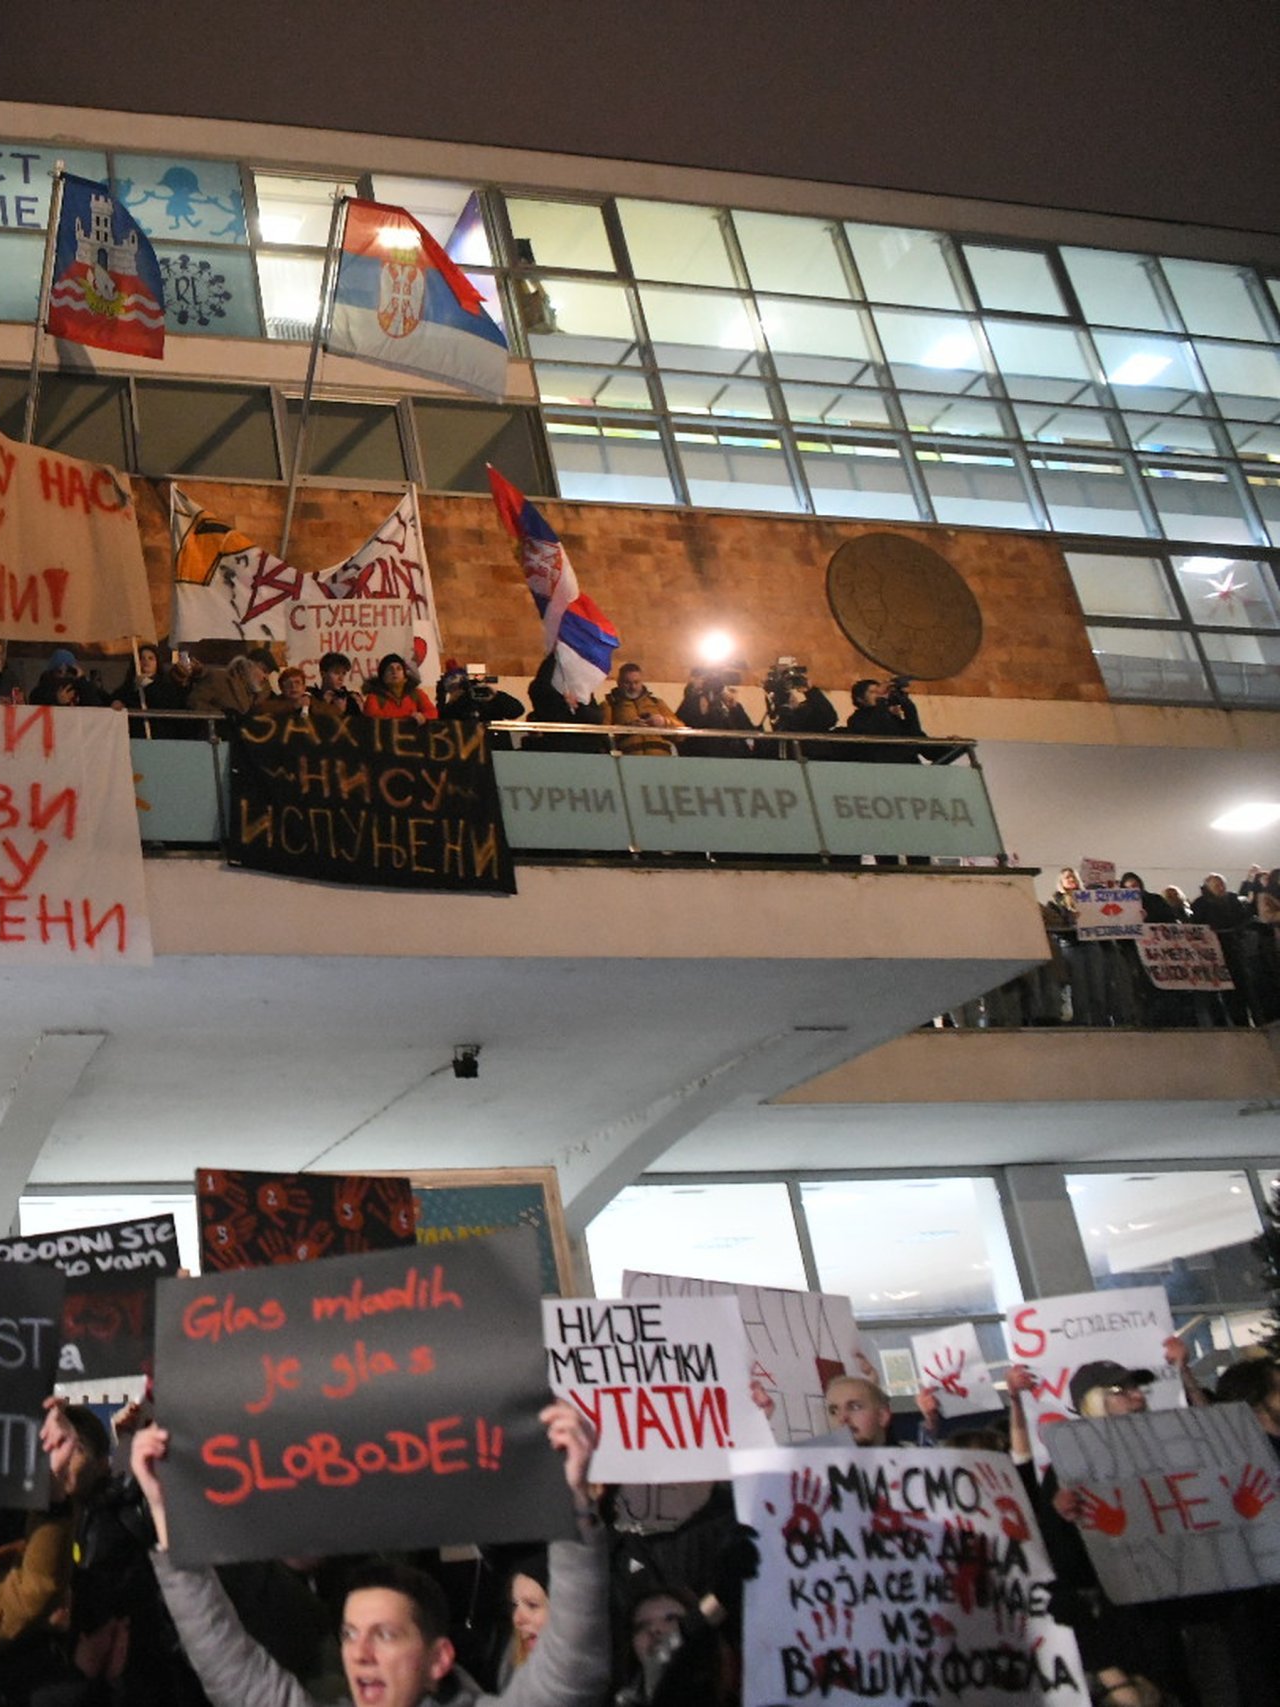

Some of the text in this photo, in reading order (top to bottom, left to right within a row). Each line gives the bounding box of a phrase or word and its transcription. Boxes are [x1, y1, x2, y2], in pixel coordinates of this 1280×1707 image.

[289, 603, 413, 631] СТУДЕНТИ
[320, 630, 379, 653] НИСУ
[298, 755, 449, 812] НИСУ
[640, 785, 799, 824] ЦЕНТАР
[833, 794, 976, 827] БЕОГРАД
[239, 798, 499, 881] ИСПУЊЕНИ
[182, 1293, 288, 1343] Glas
[311, 1263, 465, 1323] mladih
[556, 1304, 668, 1344] НИЈЕ
[244, 1338, 436, 1415] je glas
[549, 1342, 719, 1385] МЕТНИЧКИ
[568, 1385, 736, 1451] УТАТИ!
[901, 1465, 981, 1515] СМО
[1138, 1470, 1222, 1536] НЕ
[880, 1608, 936, 1649] ИЗ
